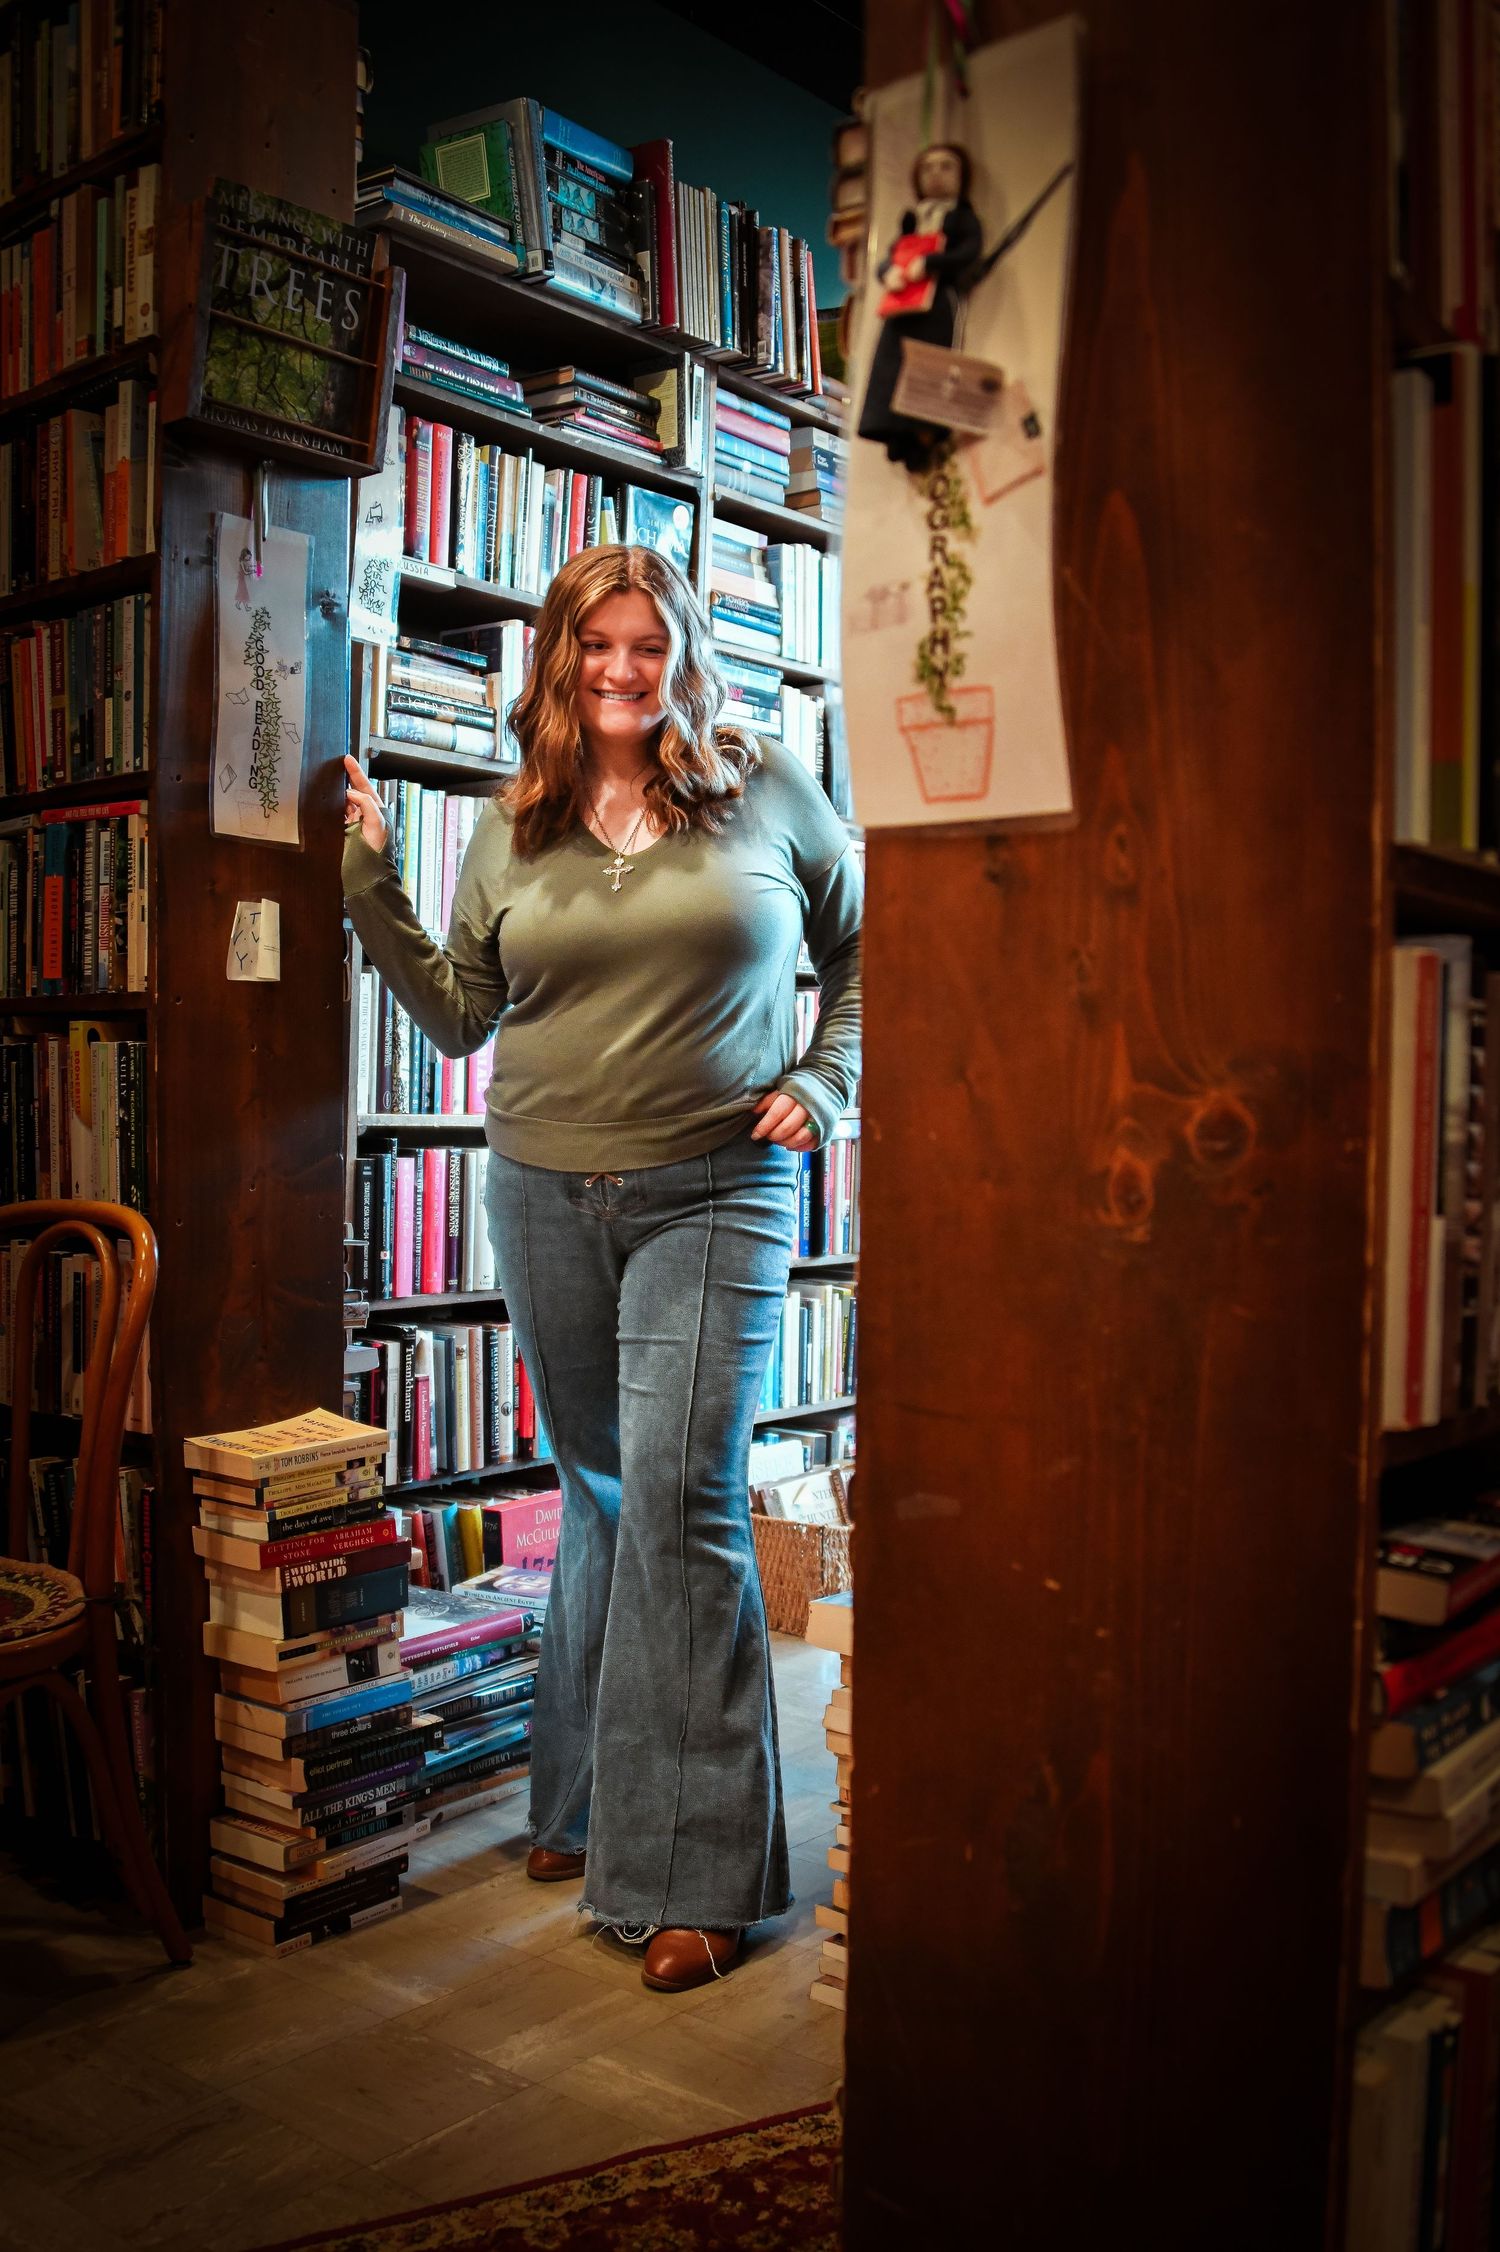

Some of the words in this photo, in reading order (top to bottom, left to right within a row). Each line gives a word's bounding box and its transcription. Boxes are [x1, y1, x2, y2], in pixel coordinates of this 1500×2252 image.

[508, 147, 516, 166] OLD
[218, 190, 314, 238] MEETINGS
[322, 229, 368, 258] WITH
[408, 213, 422, 226] The
[213, 242, 362, 332] TREES
[799, 249, 807, 297] REVOLUTION
[40, 446, 50, 474] AMY
[52, 449, 60, 481] AMY
[416, 456, 428, 471] THE
[488, 463, 499, 493] THE
[51, 488, 60, 519] TAN
[416, 475, 429, 535] WHISPERERS
[484, 500, 498, 563] DRUIDS
[585, 515, 598, 548] SWE
[400, 560, 429, 576] USSIA
[927, 472, 950, 690] OGRAPHY
[253, 637, 266, 692] GOOD
[397, 693, 451, 716] CICERO
[247, 700, 264, 790] READING
[84, 827, 94, 842] THE
[446, 807, 457, 865] GLADIUS
[84, 846, 94, 901] SUBMISSION
[50, 883, 60, 921] EUROPE
[83, 911, 93, 931] AMY
[99, 895, 112, 950] SUBMISSION
[49, 926, 59, 970] CENTRAL
[83, 933, 93, 976] WALDMAN
[119, 1055, 127, 1097] SULLY
[363, 1180, 372, 1205] STRATEGIC
[802, 1169, 811, 1197] Simple
[363, 1205, 371, 1217] ASIA
[802, 1198, 811, 1227] Justice
[403, 1344, 415, 1423] Tutankhamen
[420, 1389, 430, 1420] Federalist
[419, 1421, 429, 1442] Papers
[280, 1456, 291, 1468] TOM
[293, 1451, 319, 1466] ROBBINS
[282, 1523, 294, 1532] the
[294, 1517, 310, 1532] days
[319, 1514, 334, 1522] awe
[334, 1527, 373, 1541] ABRAHAM
[267, 1540, 306, 1554] CUTTING
[308, 1536, 326, 1548] FOR
[332, 1536, 377, 1551] VERGHESE
[515, 1528, 561, 1549] McCULL
[282, 1549, 311, 1561] STONE
[290, 1562, 318, 1577] WIDE
[319, 1556, 347, 1570] WIDE
[291, 1565, 348, 1588] WORLD
[463, 1591, 484, 1600] WOMEN
[517, 1598, 536, 1607] EGYPT
[400, 1650, 431, 1664] ETTYSBURG
[431, 1641, 459, 1655] BATTLEFIELD
[330, 1726, 349, 1739] three
[349, 1722, 372, 1734] dollars
[308, 1765, 326, 1777] eliot
[325, 1757, 354, 1773] perlman
[393, 1760, 410, 1771] MOON
[302, 1808, 322, 1825] ALL
[323, 1801, 343, 1817] THE
[344, 1790, 375, 1808] KING'S
[375, 1780, 397, 1797] MEN
